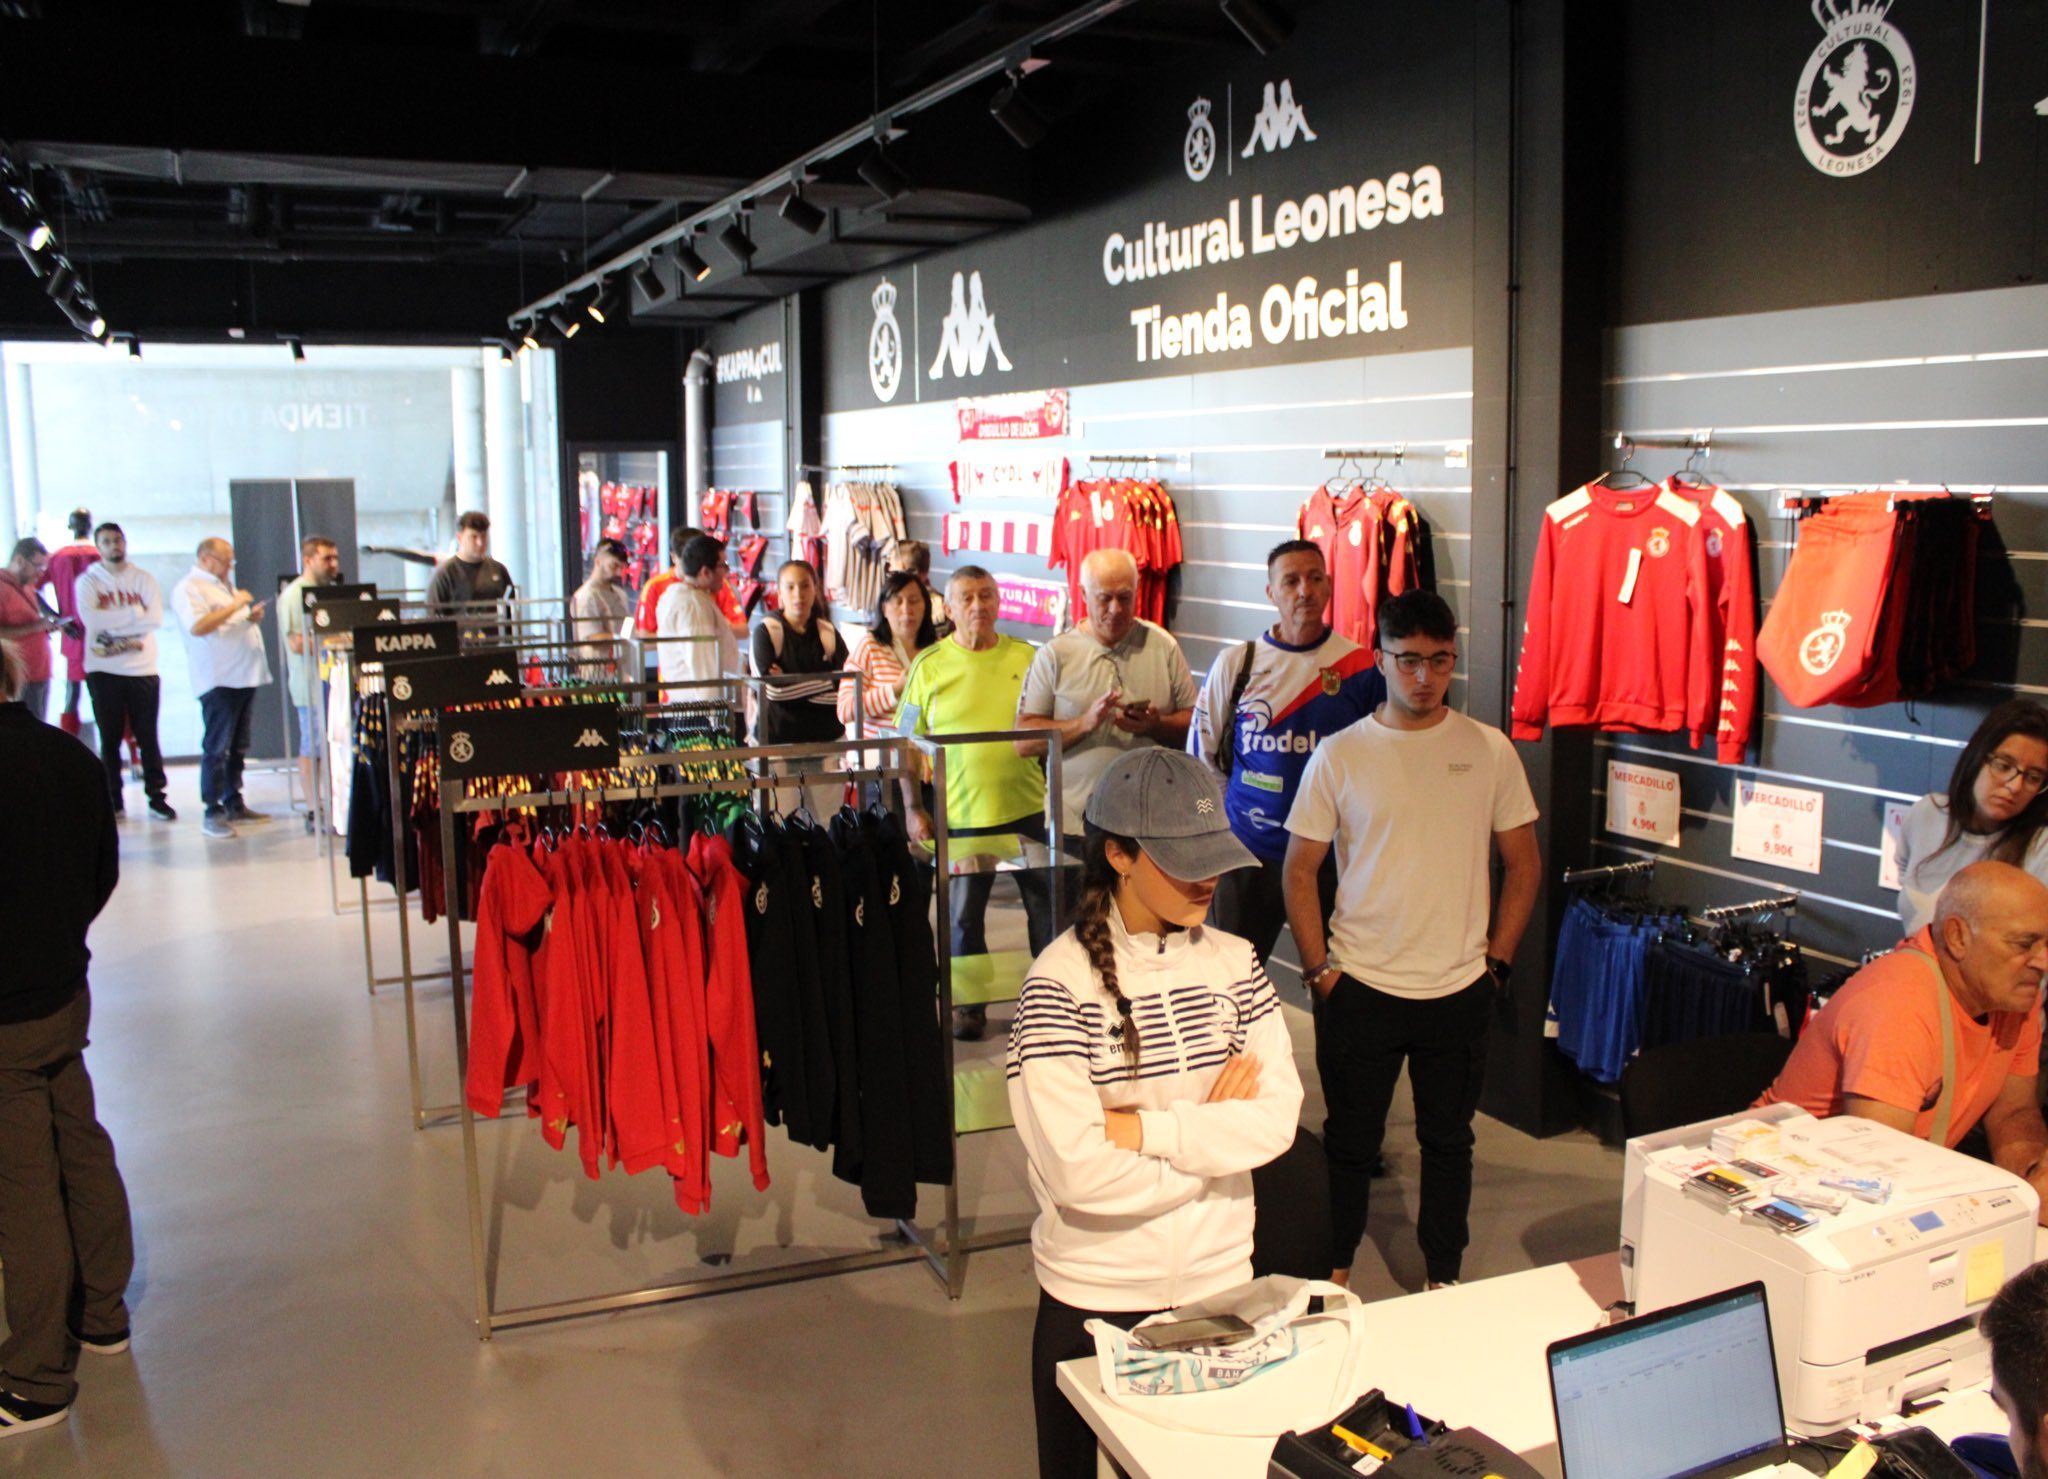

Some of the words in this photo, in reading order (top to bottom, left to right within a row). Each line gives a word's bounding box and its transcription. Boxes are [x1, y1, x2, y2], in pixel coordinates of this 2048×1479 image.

[1818, 22, 1891, 59] CULTURAL
[1900, 65, 1912, 106] 1923
[1818, 145, 1886, 172] LEONESA
[1103, 198, 1244, 286] Cultural
[1251, 164, 1443, 255] Leonesa
[1130, 292, 1253, 362] Tienda
[1260, 260, 1409, 344] Oficial
[999, 587, 1038, 609] TURAL
[374, 632, 437, 653] KAPPA
[1614, 770, 1674, 792] MERCADILLO
[1745, 790, 1815, 813] MERCADILLO
[1763, 841, 1794, 858] 9,90€
[1216, 1367, 1241, 1379] BAH
